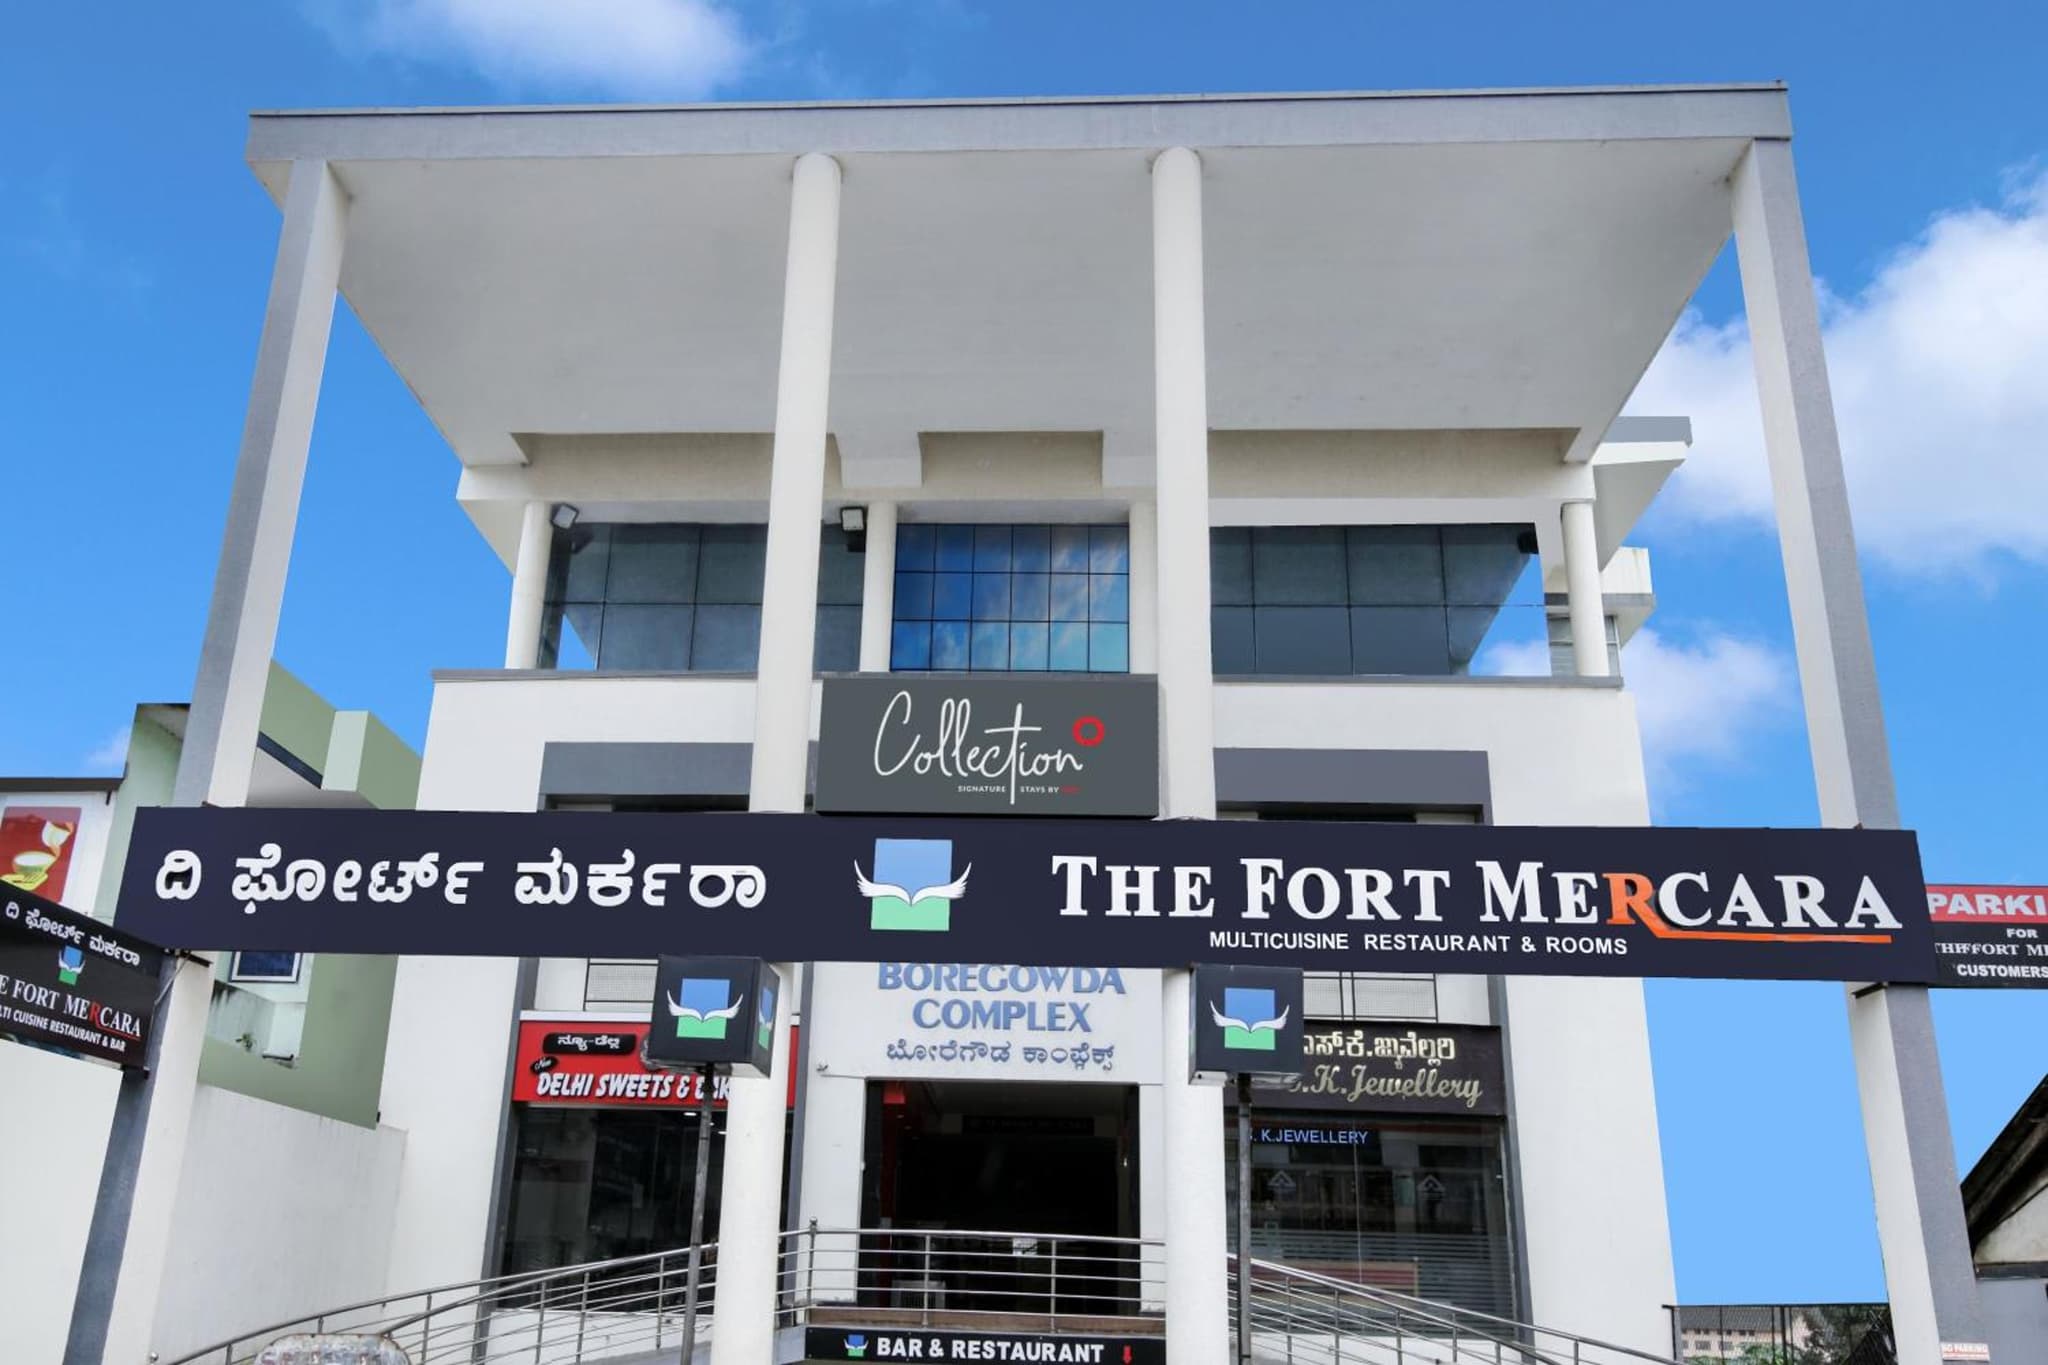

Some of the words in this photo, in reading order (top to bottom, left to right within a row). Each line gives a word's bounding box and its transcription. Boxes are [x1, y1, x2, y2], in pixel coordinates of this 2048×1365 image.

[874, 689, 1083, 805] Collection
[957, 784, 1006, 794] SIGNATURE
[1020, 785, 1046, 794] STAYS
[1048, 786, 1060, 794] BY
[155, 849, 202, 901] ದಿ
[514, 846, 767, 909] ಮರ್ಕರಾ
[5, 901, 20, 919] ದಿ
[89, 934, 141, 966] ಮರ್ಕರಾ
[1209, 930, 1349, 950] MULTICUISINE
[1364, 934, 1510, 953] RESTAURANT
[1521, 936, 1537, 953] &
[1546, 937, 1628, 955] ROOMS
[2006, 928, 2038, 939] FOR
[878, 962, 1127, 995] BOREGOWDA
[1956, 964, 2048, 978] CUSTOMERS
[12, 979, 60, 1009] FORT
[63, 994, 142, 1037] MERCARA
[912, 998, 1093, 1033] COMPLEX
[12, 1009, 50, 1031] CUISINE
[49, 1019, 103, 1047] RESTAURANT
[101, 1037, 110, 1048] &
[109, 1039, 127, 1053] BAR
[536, 1072, 595, 1097] DELHI
[594, 1073, 675, 1098] SWEETS
[676, 1075, 690, 1099] &
[876, 1337, 923, 1358] BAR
[927, 1338, 945, 1358] &
[951, 1339, 1105, 1364] RESTAURANT
